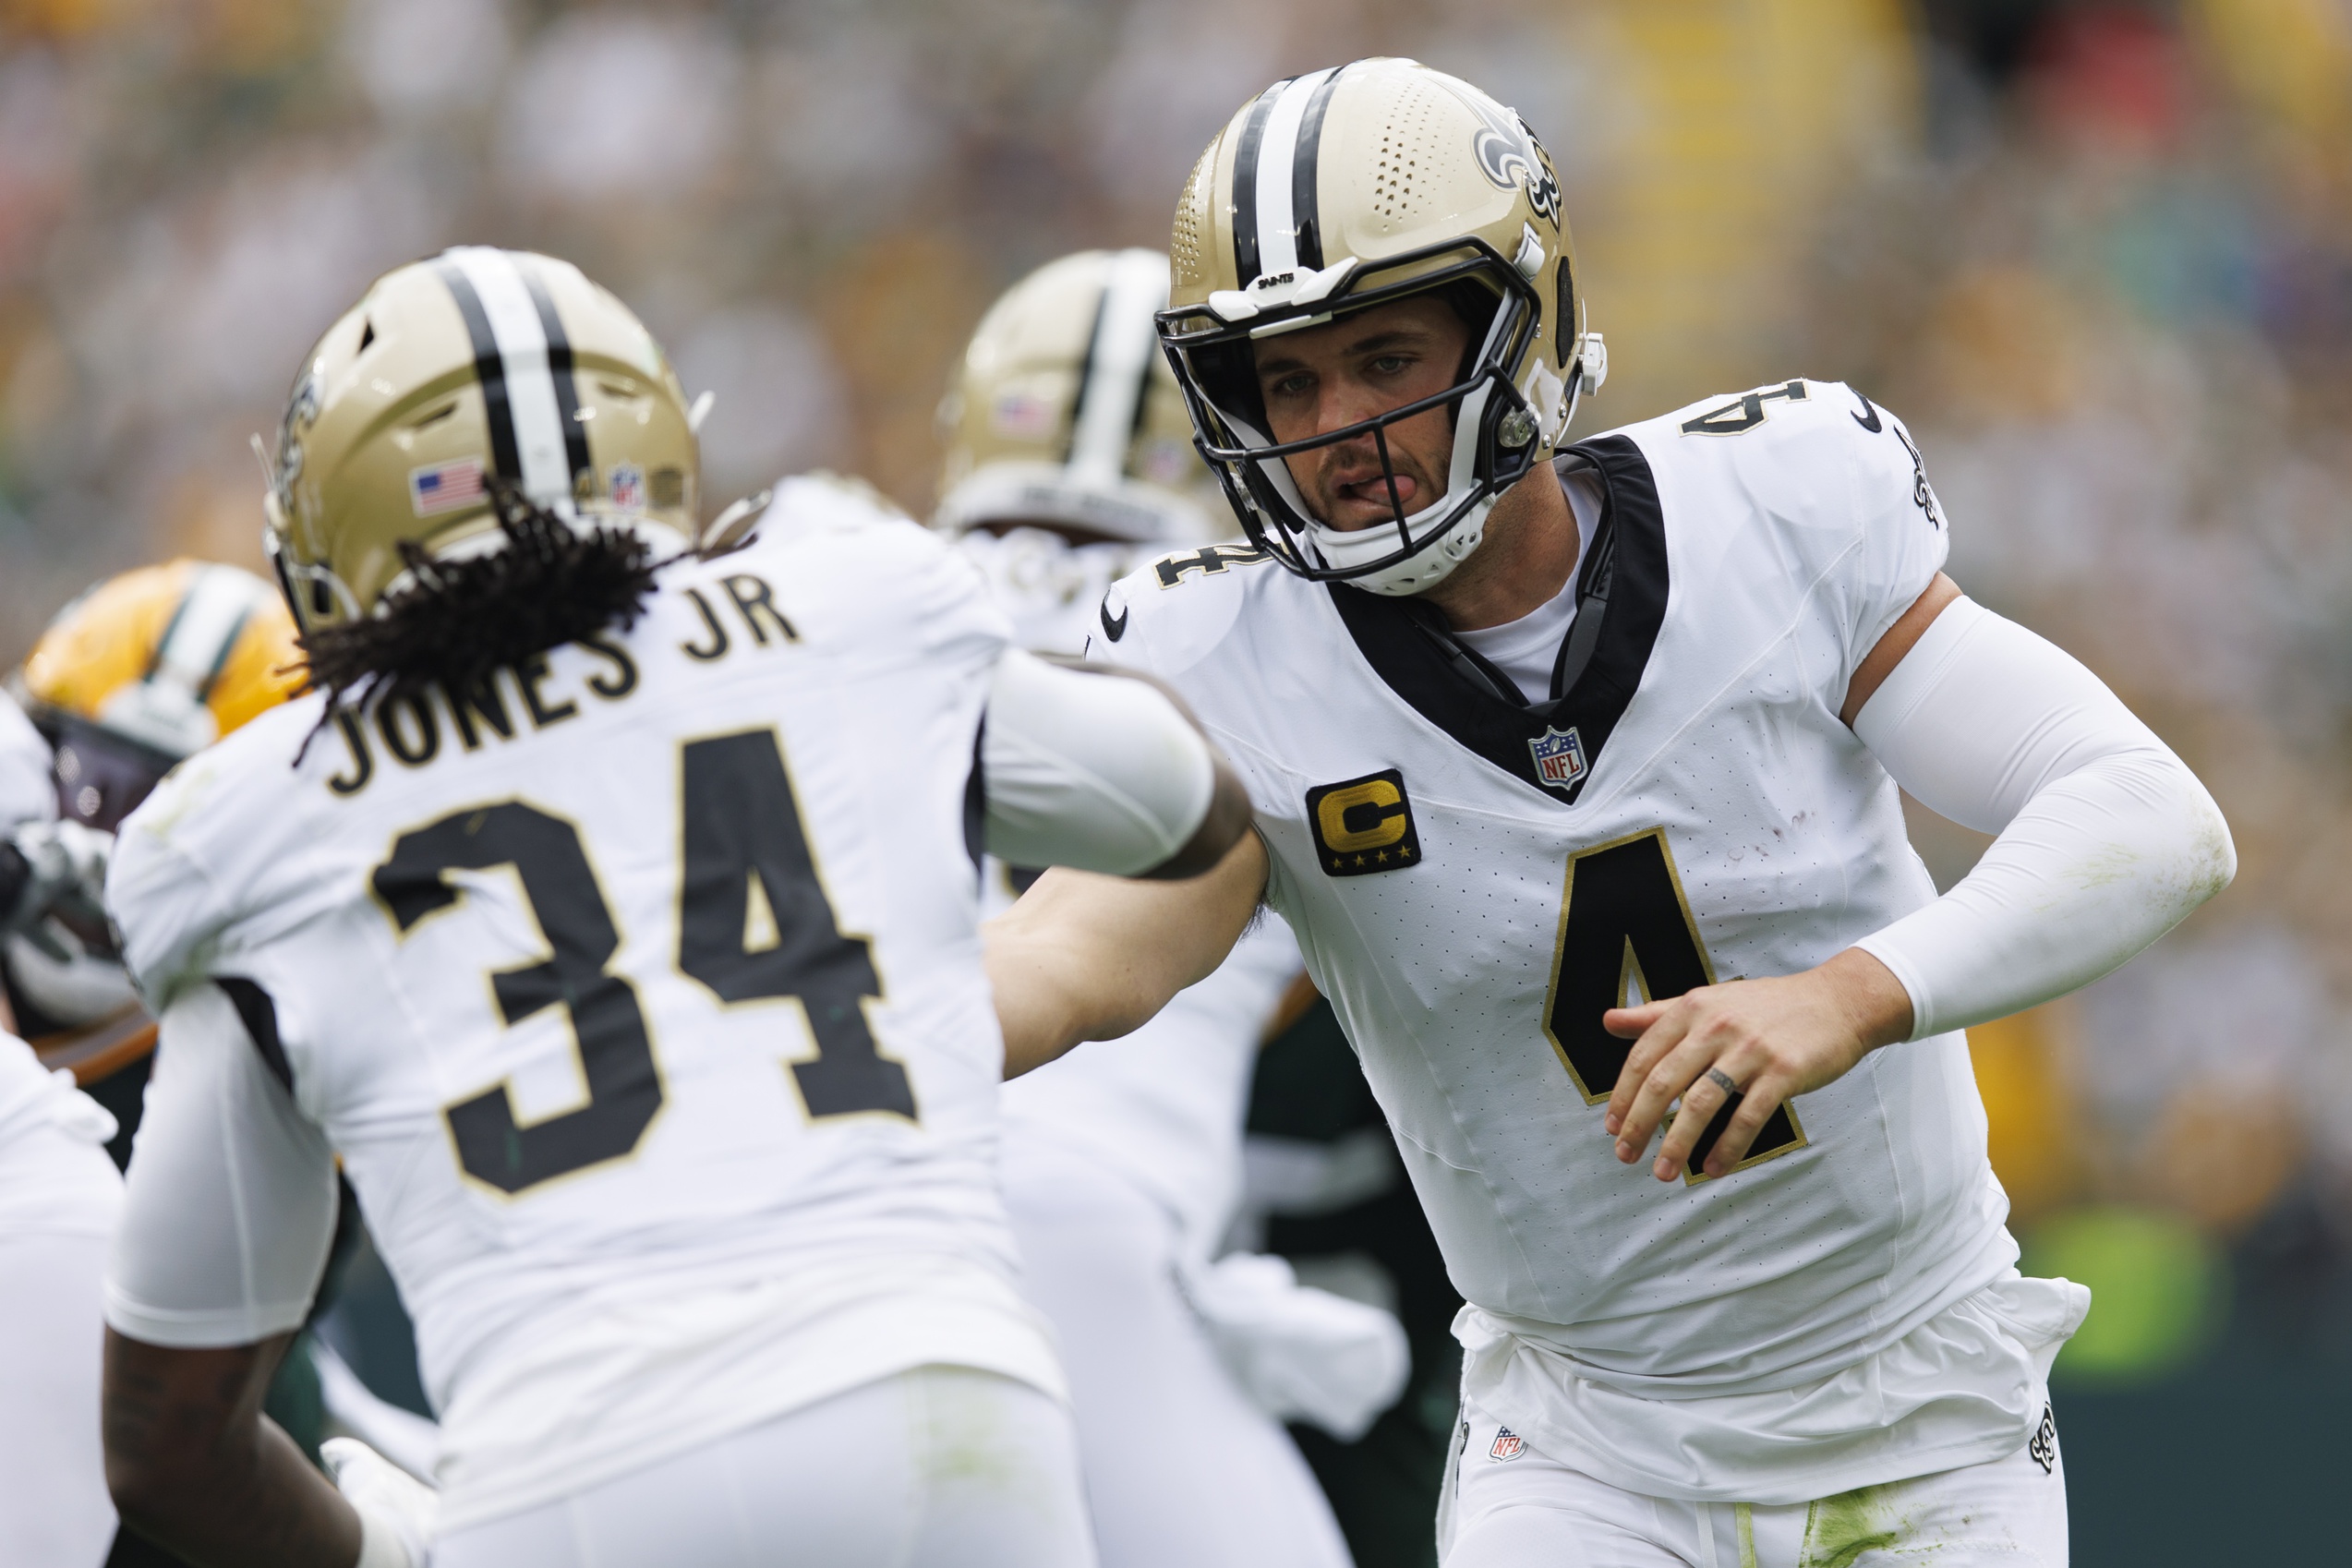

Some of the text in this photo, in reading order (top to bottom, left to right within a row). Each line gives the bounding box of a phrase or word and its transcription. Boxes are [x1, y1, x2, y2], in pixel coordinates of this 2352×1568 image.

[1258, 272, 1295, 290] SAINTS
[1677, 379, 1812, 438] 4
[328, 573, 803, 797] JONES JR
[1542, 754, 1580, 780] NFL
[1316, 778, 1408, 854] C
[368, 721, 923, 1196] 34
[1541, 824, 1809, 1188] 4
[1493, 1438, 1521, 1456] NFL
